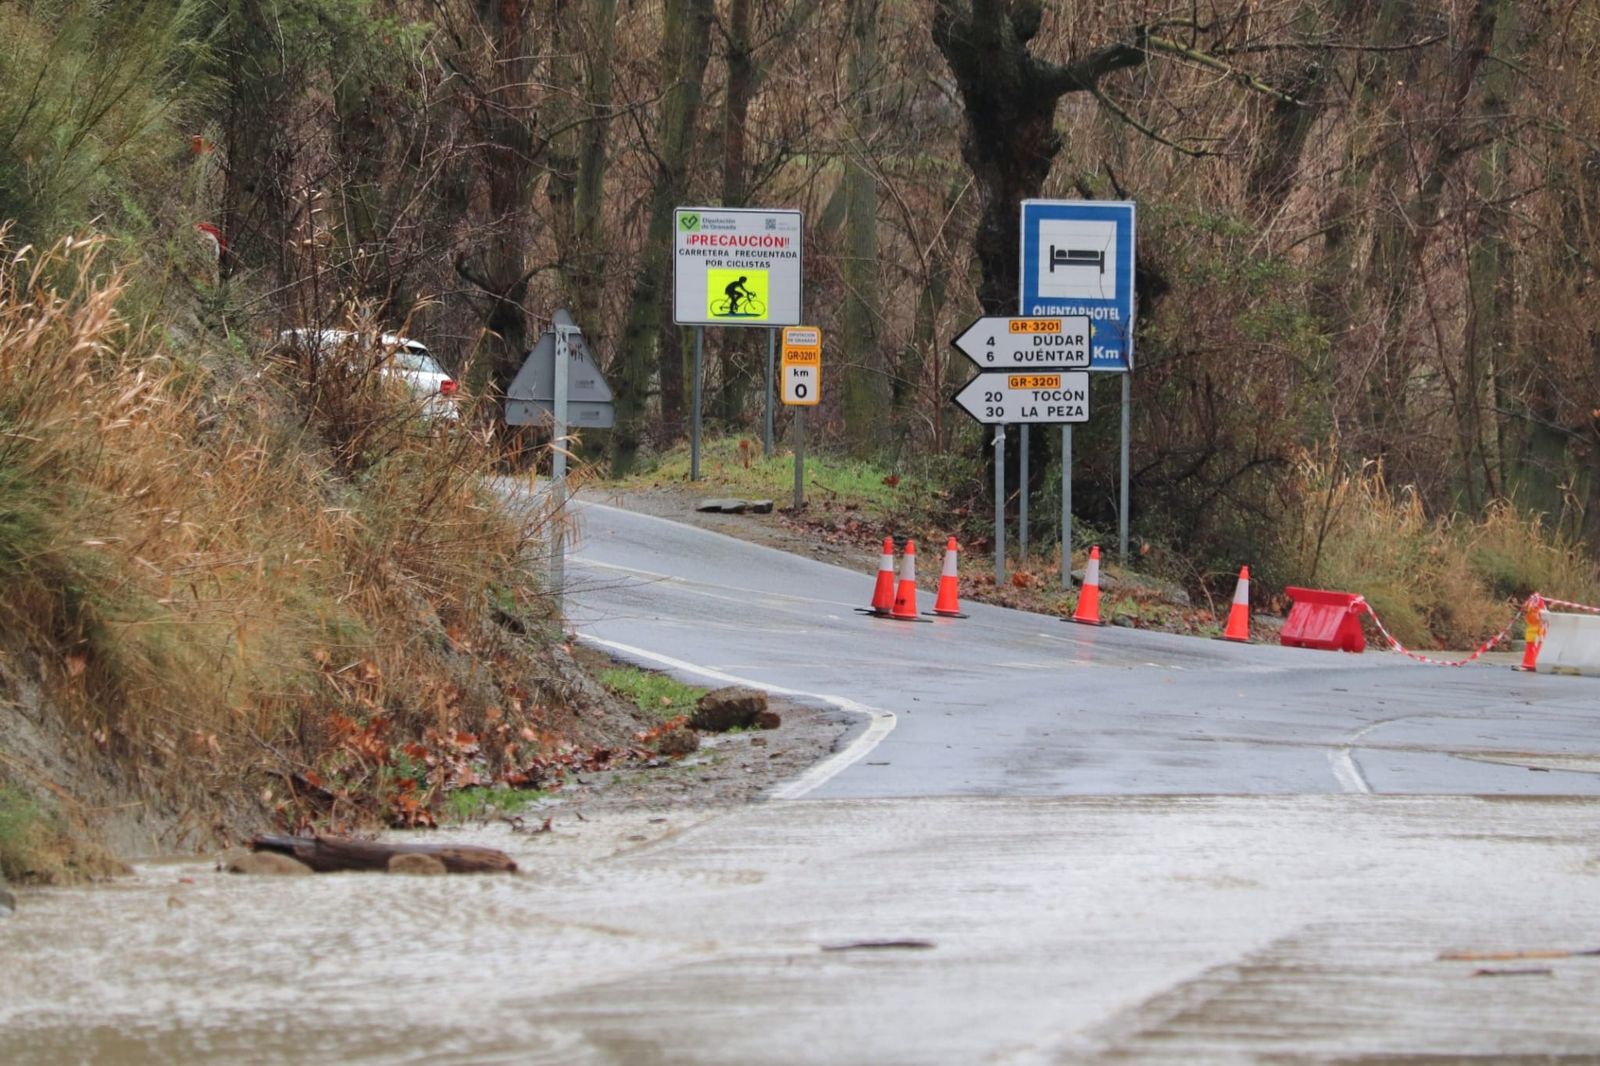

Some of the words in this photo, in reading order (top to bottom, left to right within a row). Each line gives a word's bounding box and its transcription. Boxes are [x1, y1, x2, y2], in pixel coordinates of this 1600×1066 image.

[679, 248, 729, 257] CARRETERA
[735, 250, 798, 258] FRECUENTADA
[1011, 321, 1059, 332] GR-3201
[986, 336, 996, 347] 4
[1033, 333, 1084, 346] DÚDAR
[787, 351, 816, 360] GR-3201
[986, 351, 995, 362] 6
[1013, 348, 1084, 362] QUÉNTAR
[1093, 346, 1119, 359] Km
[793, 368, 809, 377] km
[1010, 376, 1059, 387] GR-3201
[795, 383, 807, 398] 0
[985, 391, 1003, 403] 20
[1032, 389, 1084, 402] TOCÓN
[986, 406, 1004, 417] 30
[1021, 406, 1039, 417] LA
[1047, 406, 1084, 417] PEZA
